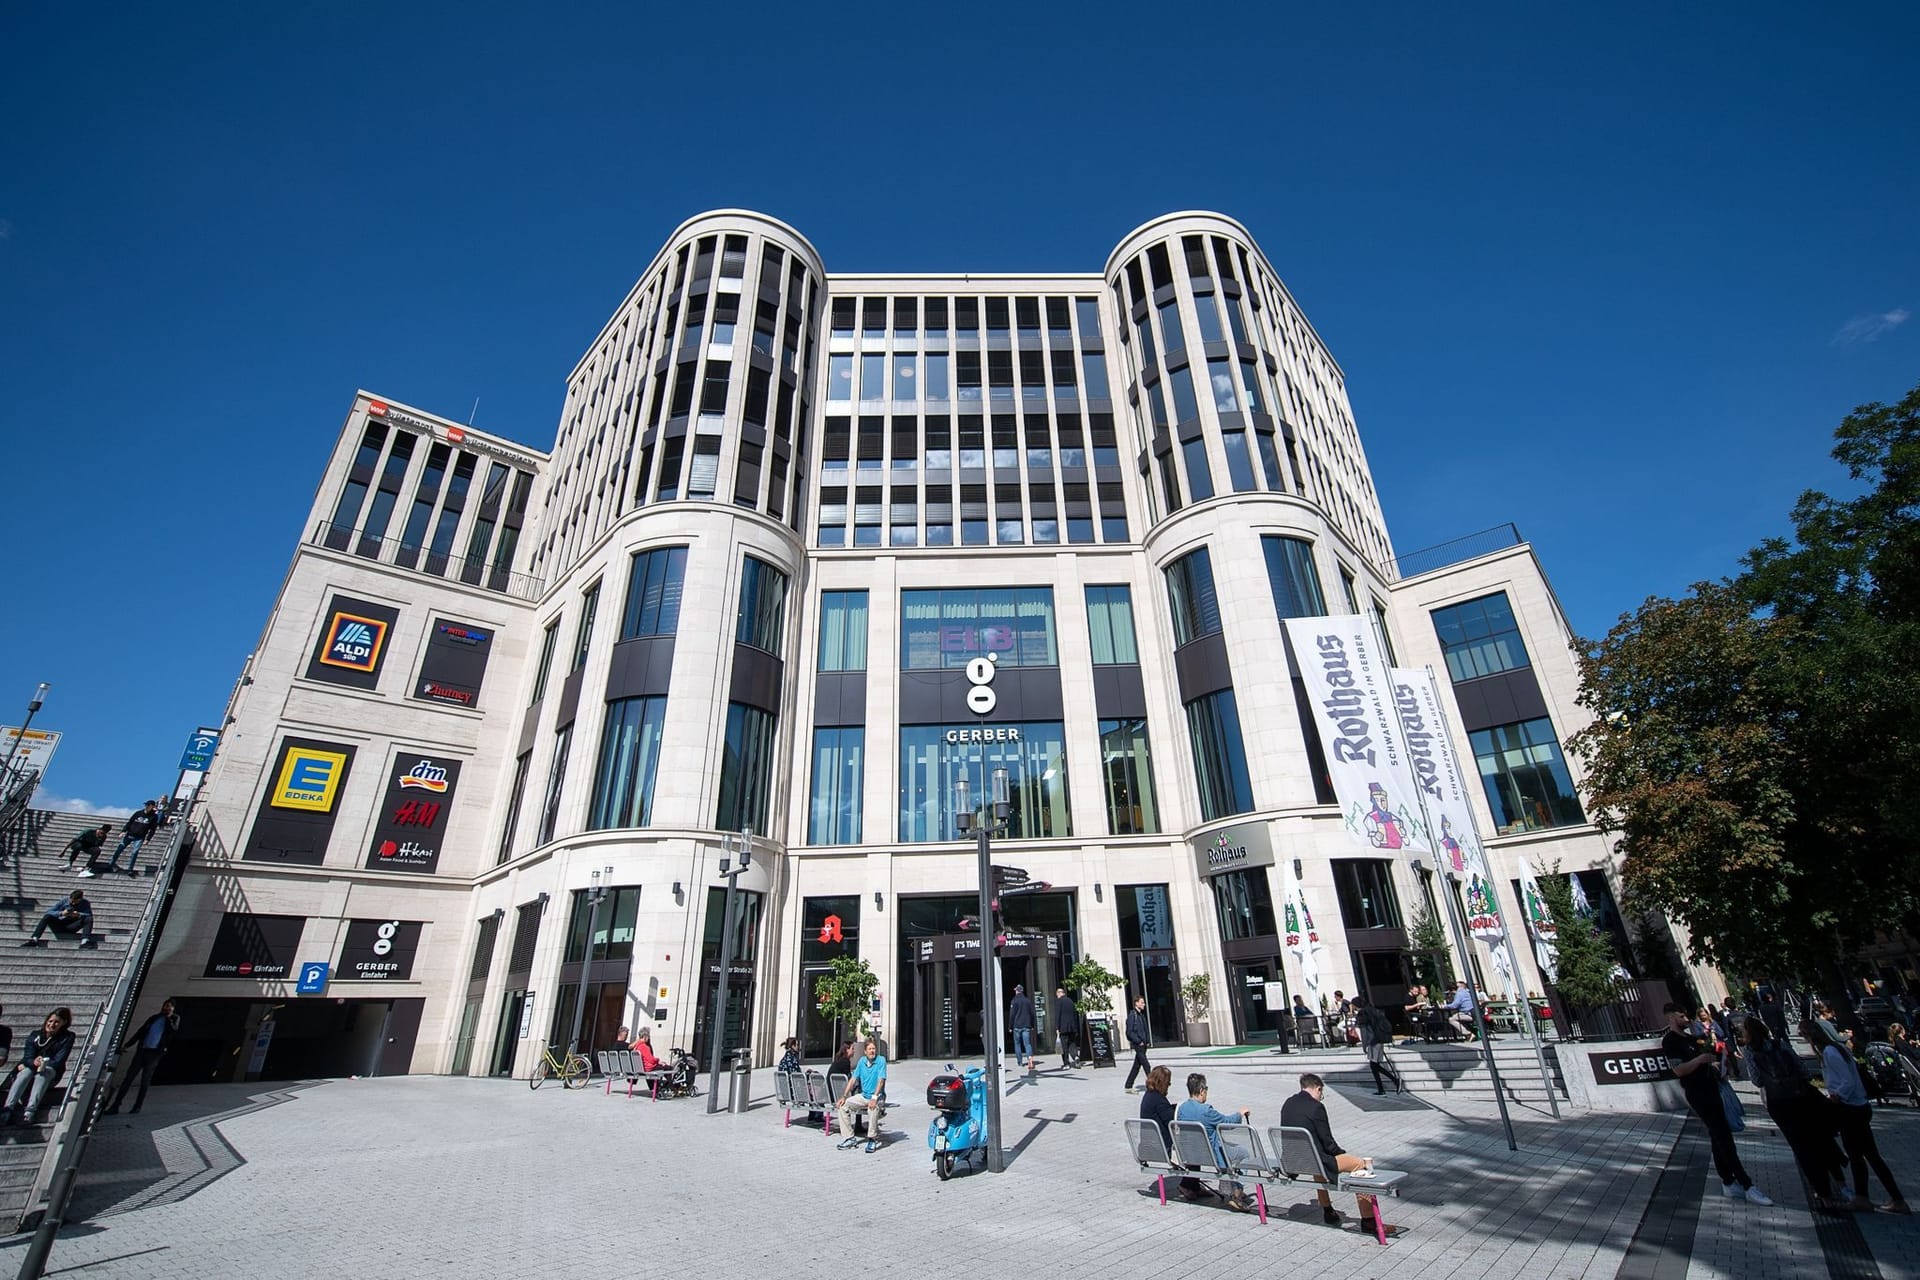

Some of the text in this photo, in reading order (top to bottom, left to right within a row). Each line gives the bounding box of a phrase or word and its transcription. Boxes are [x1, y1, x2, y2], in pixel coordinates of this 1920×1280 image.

[333, 643, 370, 657] ALDI
[1317, 634, 1376, 769] Rothaus
[1355, 634, 1398, 766] SCHWARZWALD IM GERBER
[946, 728, 1020, 742] GERBER
[411, 761, 446, 781] dm
[1437, 732, 1460, 801] SCHWARZWALD
[285, 791, 323, 802] EDEKA
[392, 800, 440, 829] H&M
[1208, 846, 1247, 865] Rothaus
[216, 964, 284, 973] Keine Einfahrt
[356, 962, 398, 971] GERBER
